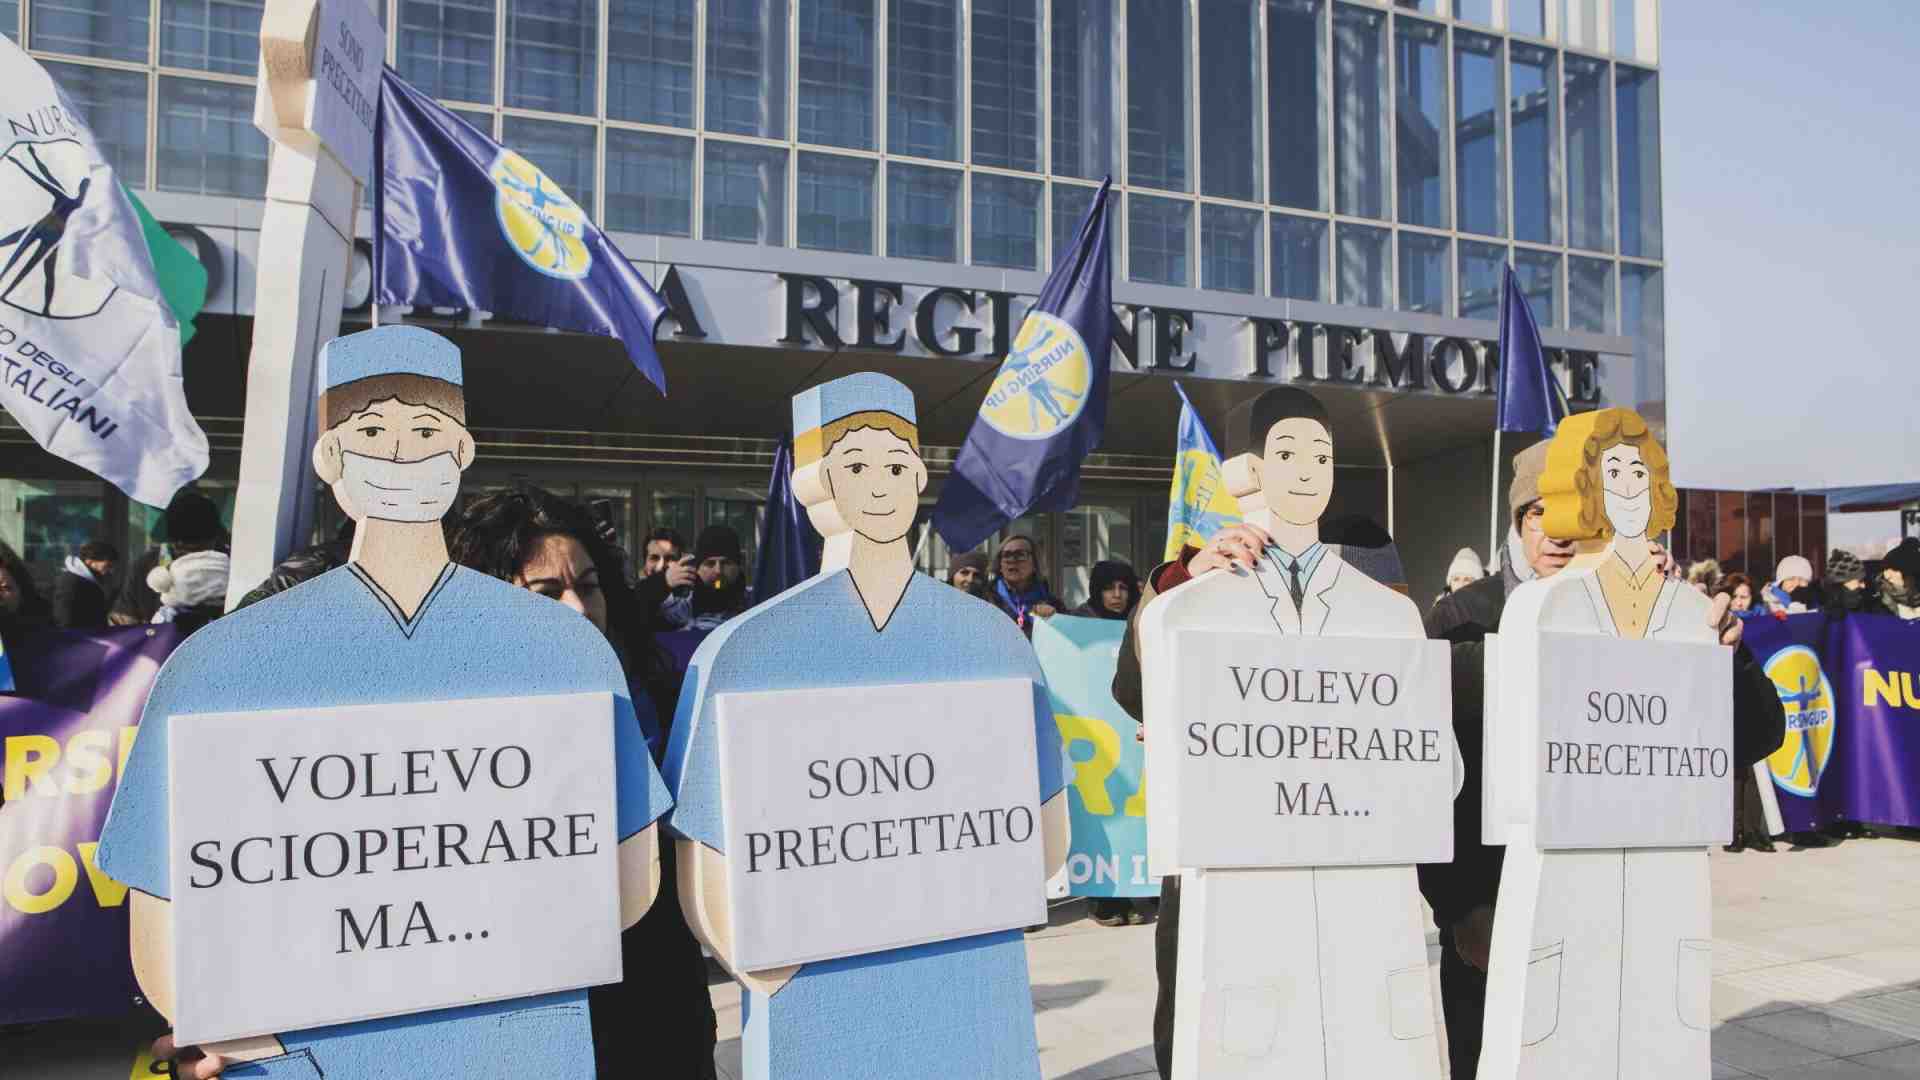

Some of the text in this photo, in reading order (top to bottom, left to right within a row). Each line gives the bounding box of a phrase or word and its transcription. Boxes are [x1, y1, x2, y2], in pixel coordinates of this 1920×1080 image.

[777, 272, 1197, 373] REGINE
[1247, 317, 1601, 405] PIEMOE
[17, 341, 86, 387] DEGLI
[0, 355, 118, 440] TALIANI
[1229, 667, 1398, 706] VOLEVO
[1587, 691, 1667, 726] SONO
[1188, 722, 1441, 762] SCIOPERARE
[1545, 741, 1729, 778] PRECETTATO
[256, 745, 531, 803] VOLEVO
[808, 752, 935, 799] SONO
[1275, 783, 1370, 817] MA...
[189, 812, 598, 889] SCIOPERARE
[745, 804, 1034, 873] PRECETTATO
[335, 900, 489, 954] MA...
